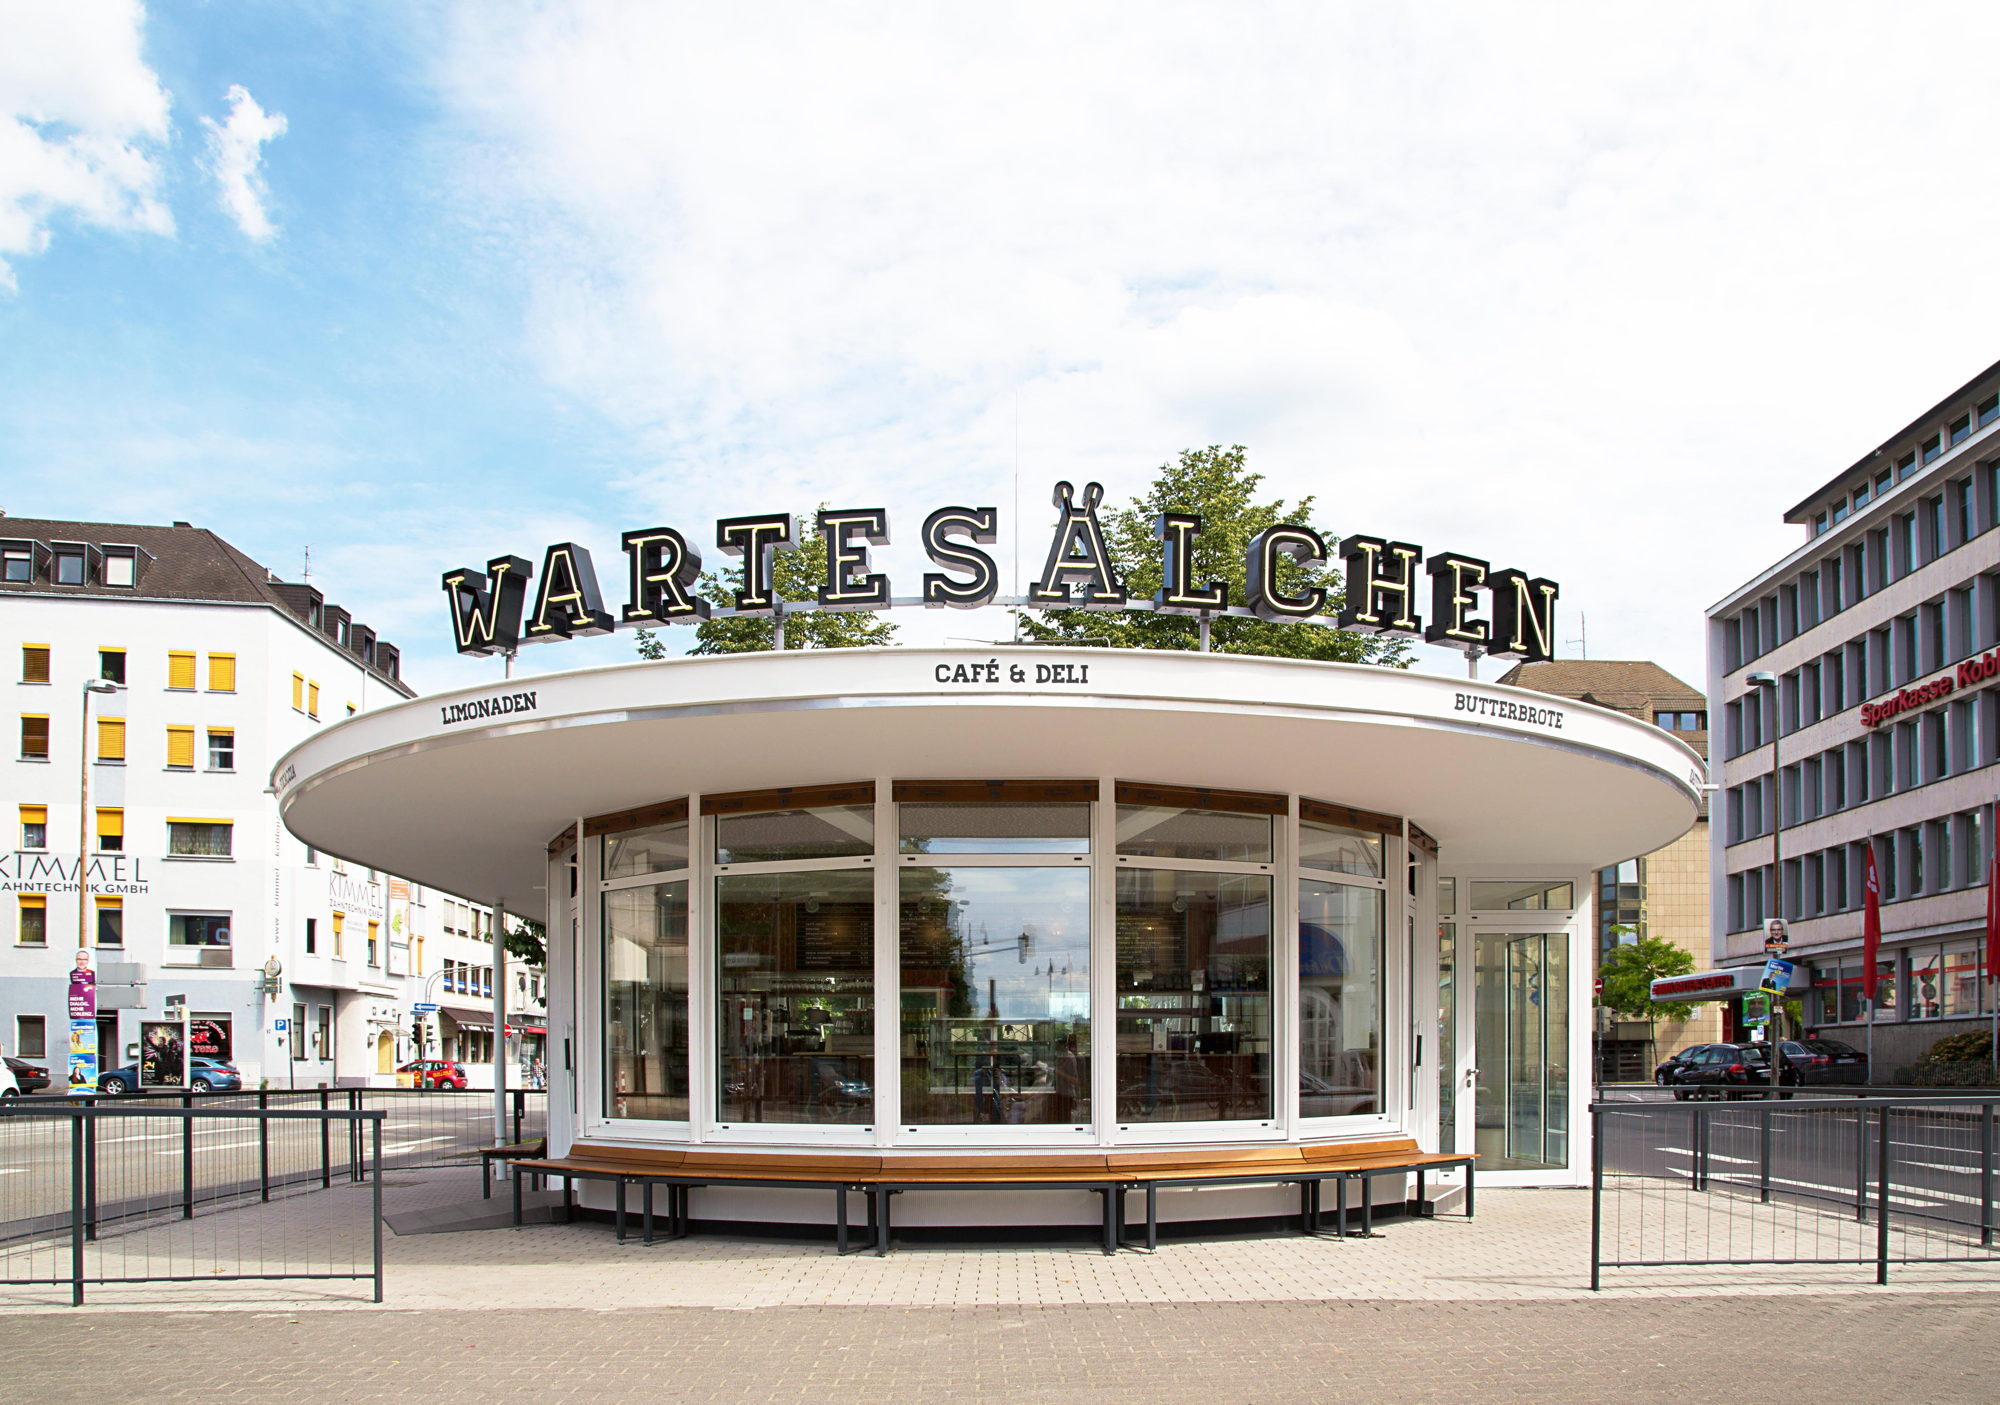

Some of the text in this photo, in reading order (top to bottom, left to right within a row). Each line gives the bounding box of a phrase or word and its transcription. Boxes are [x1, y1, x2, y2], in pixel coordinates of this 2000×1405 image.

[442, 480, 1559, 663] WARTESÄLCHEN
[935, 658, 1089, 684] CAFÉ & DELI
[441, 691, 537, 725] LIMONADEN
[1454, 693, 1563, 729] BUTTERBROTE
[1860, 676, 1954, 728] Sparkasse
[105, 884, 149, 894] GMBH
[329, 872, 383, 909] KIMMEL
[277, 1020, 285, 1030] P
